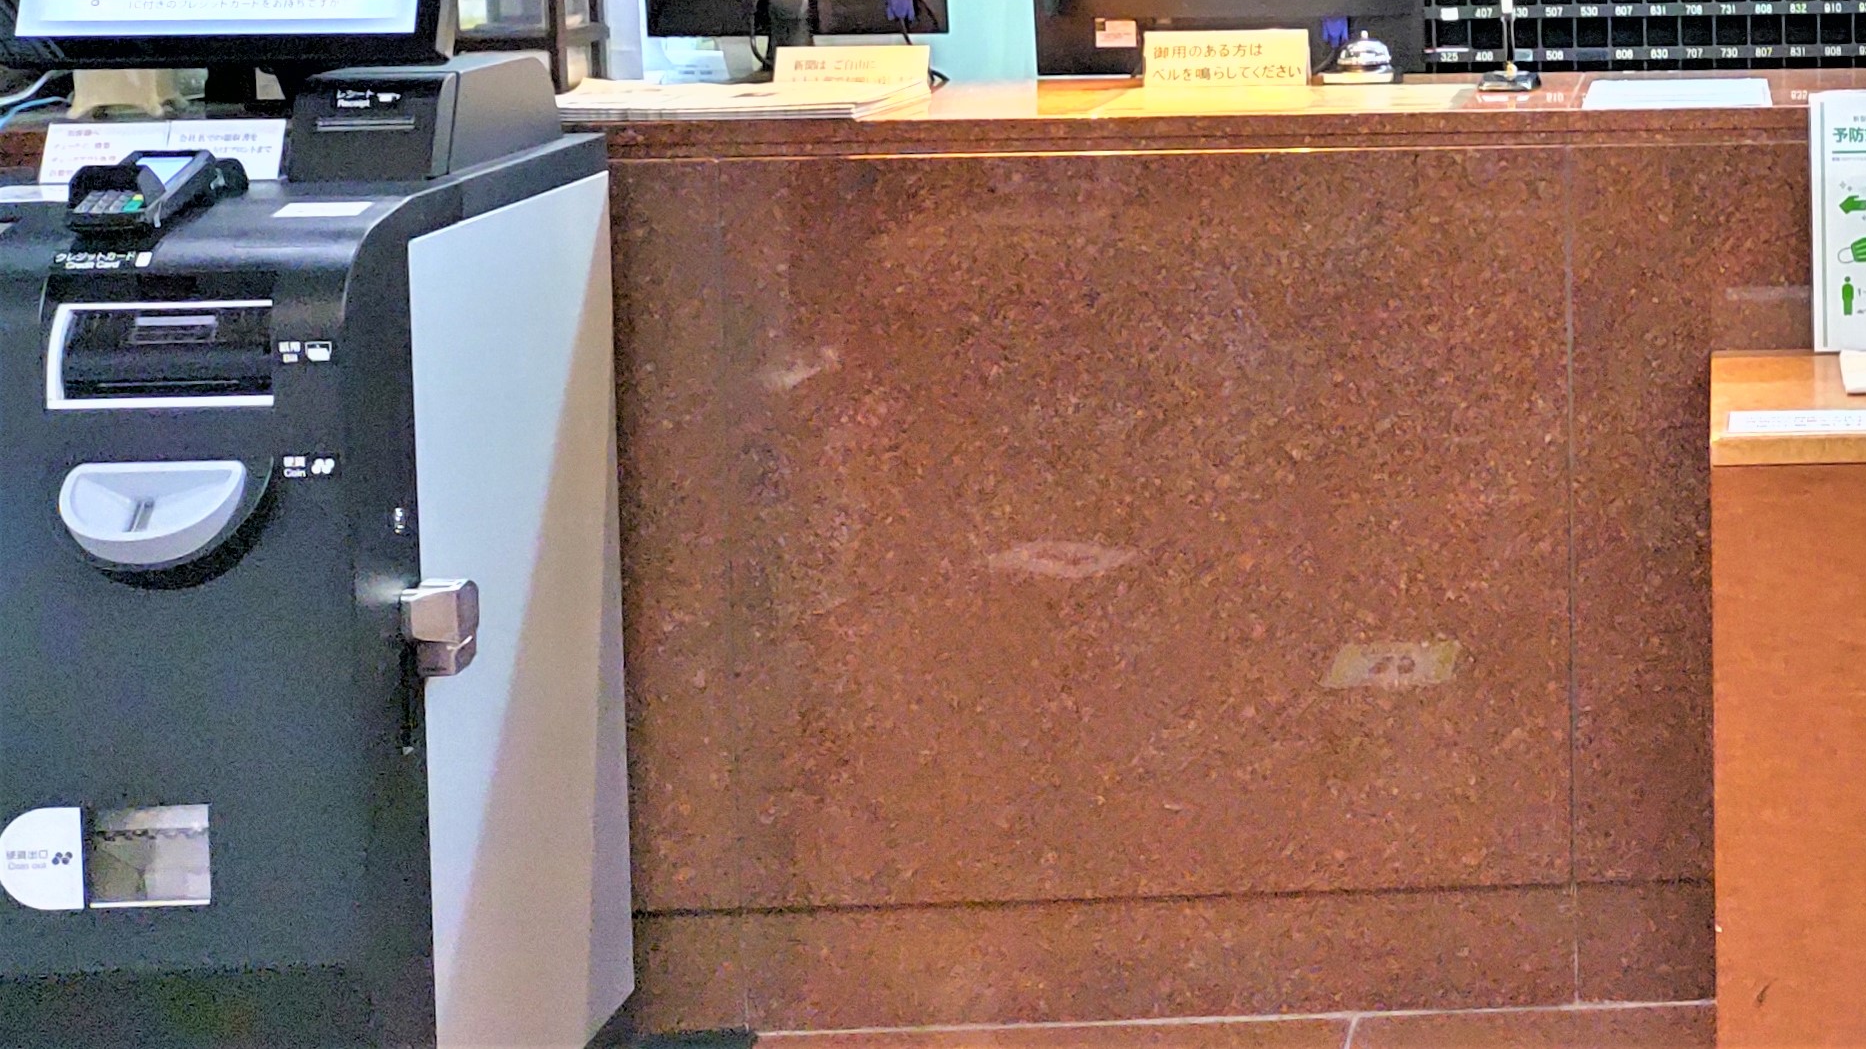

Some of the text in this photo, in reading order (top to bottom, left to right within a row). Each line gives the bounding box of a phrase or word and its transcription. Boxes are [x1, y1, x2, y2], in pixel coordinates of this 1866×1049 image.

[1153, 44, 1263, 59] 御用のある方は
[1152, 64, 1301, 82] ベルを鳴らしてください
